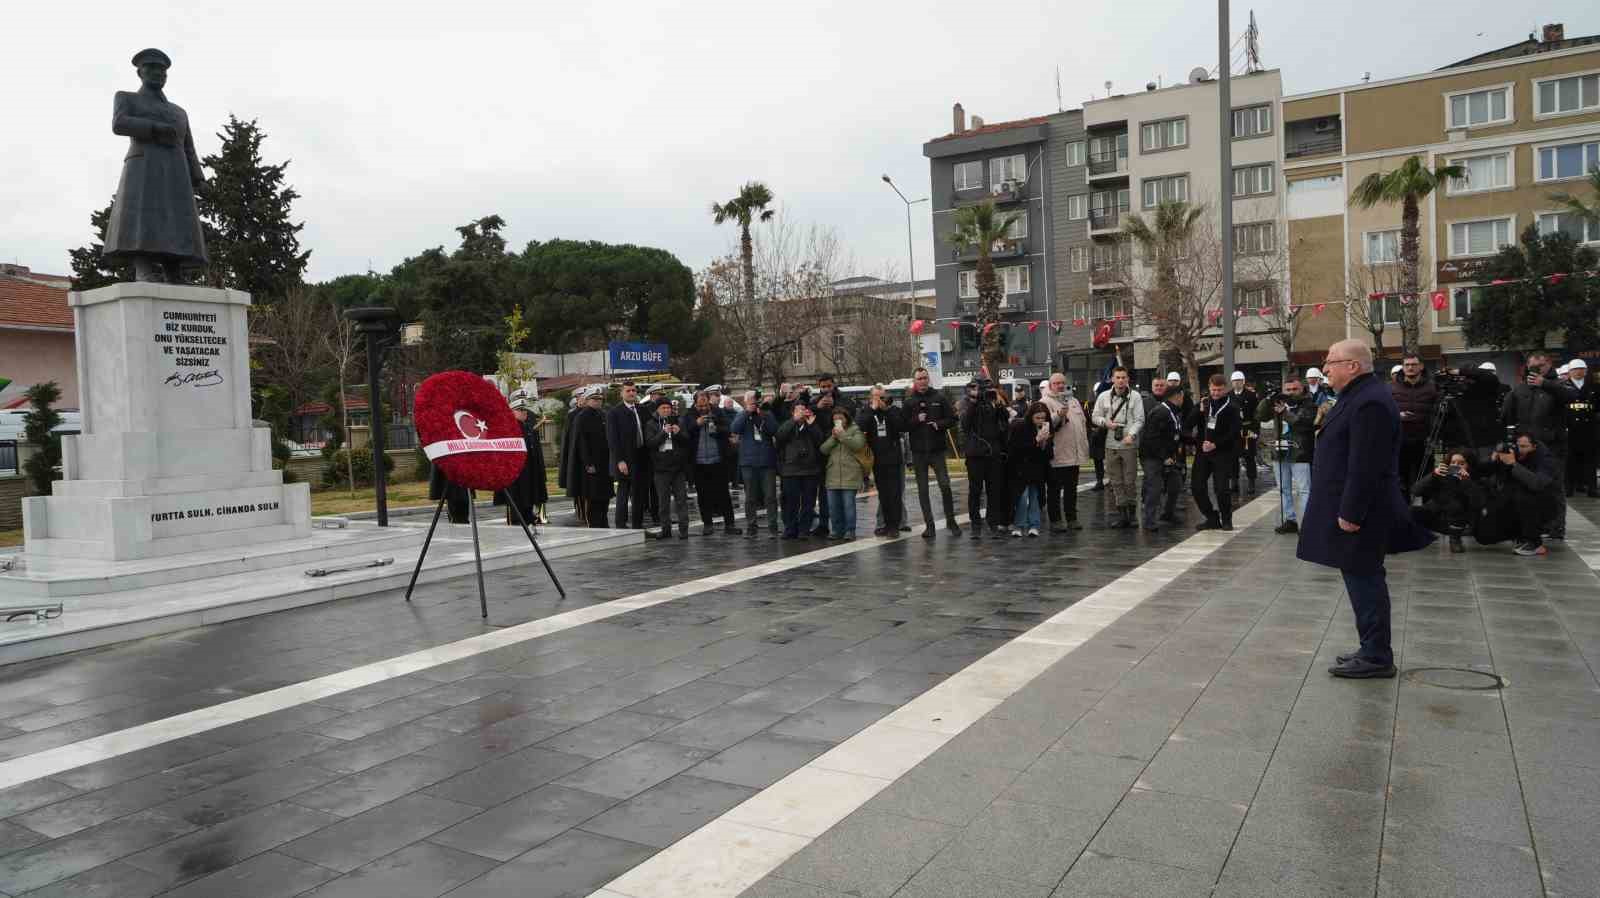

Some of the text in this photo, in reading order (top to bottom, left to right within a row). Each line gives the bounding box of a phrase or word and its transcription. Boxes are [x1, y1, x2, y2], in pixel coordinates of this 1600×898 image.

[163, 311, 217, 322] CUMHURİYETİ
[166, 321, 179, 332] BİZ
[154, 333, 227, 345] ONU YÜKSELTECEK
[163, 346, 174, 354] VE
[620, 351, 641, 361] ARZU
[216, 504, 255, 515] CİHANDA
[257, 501, 279, 511] SULH
